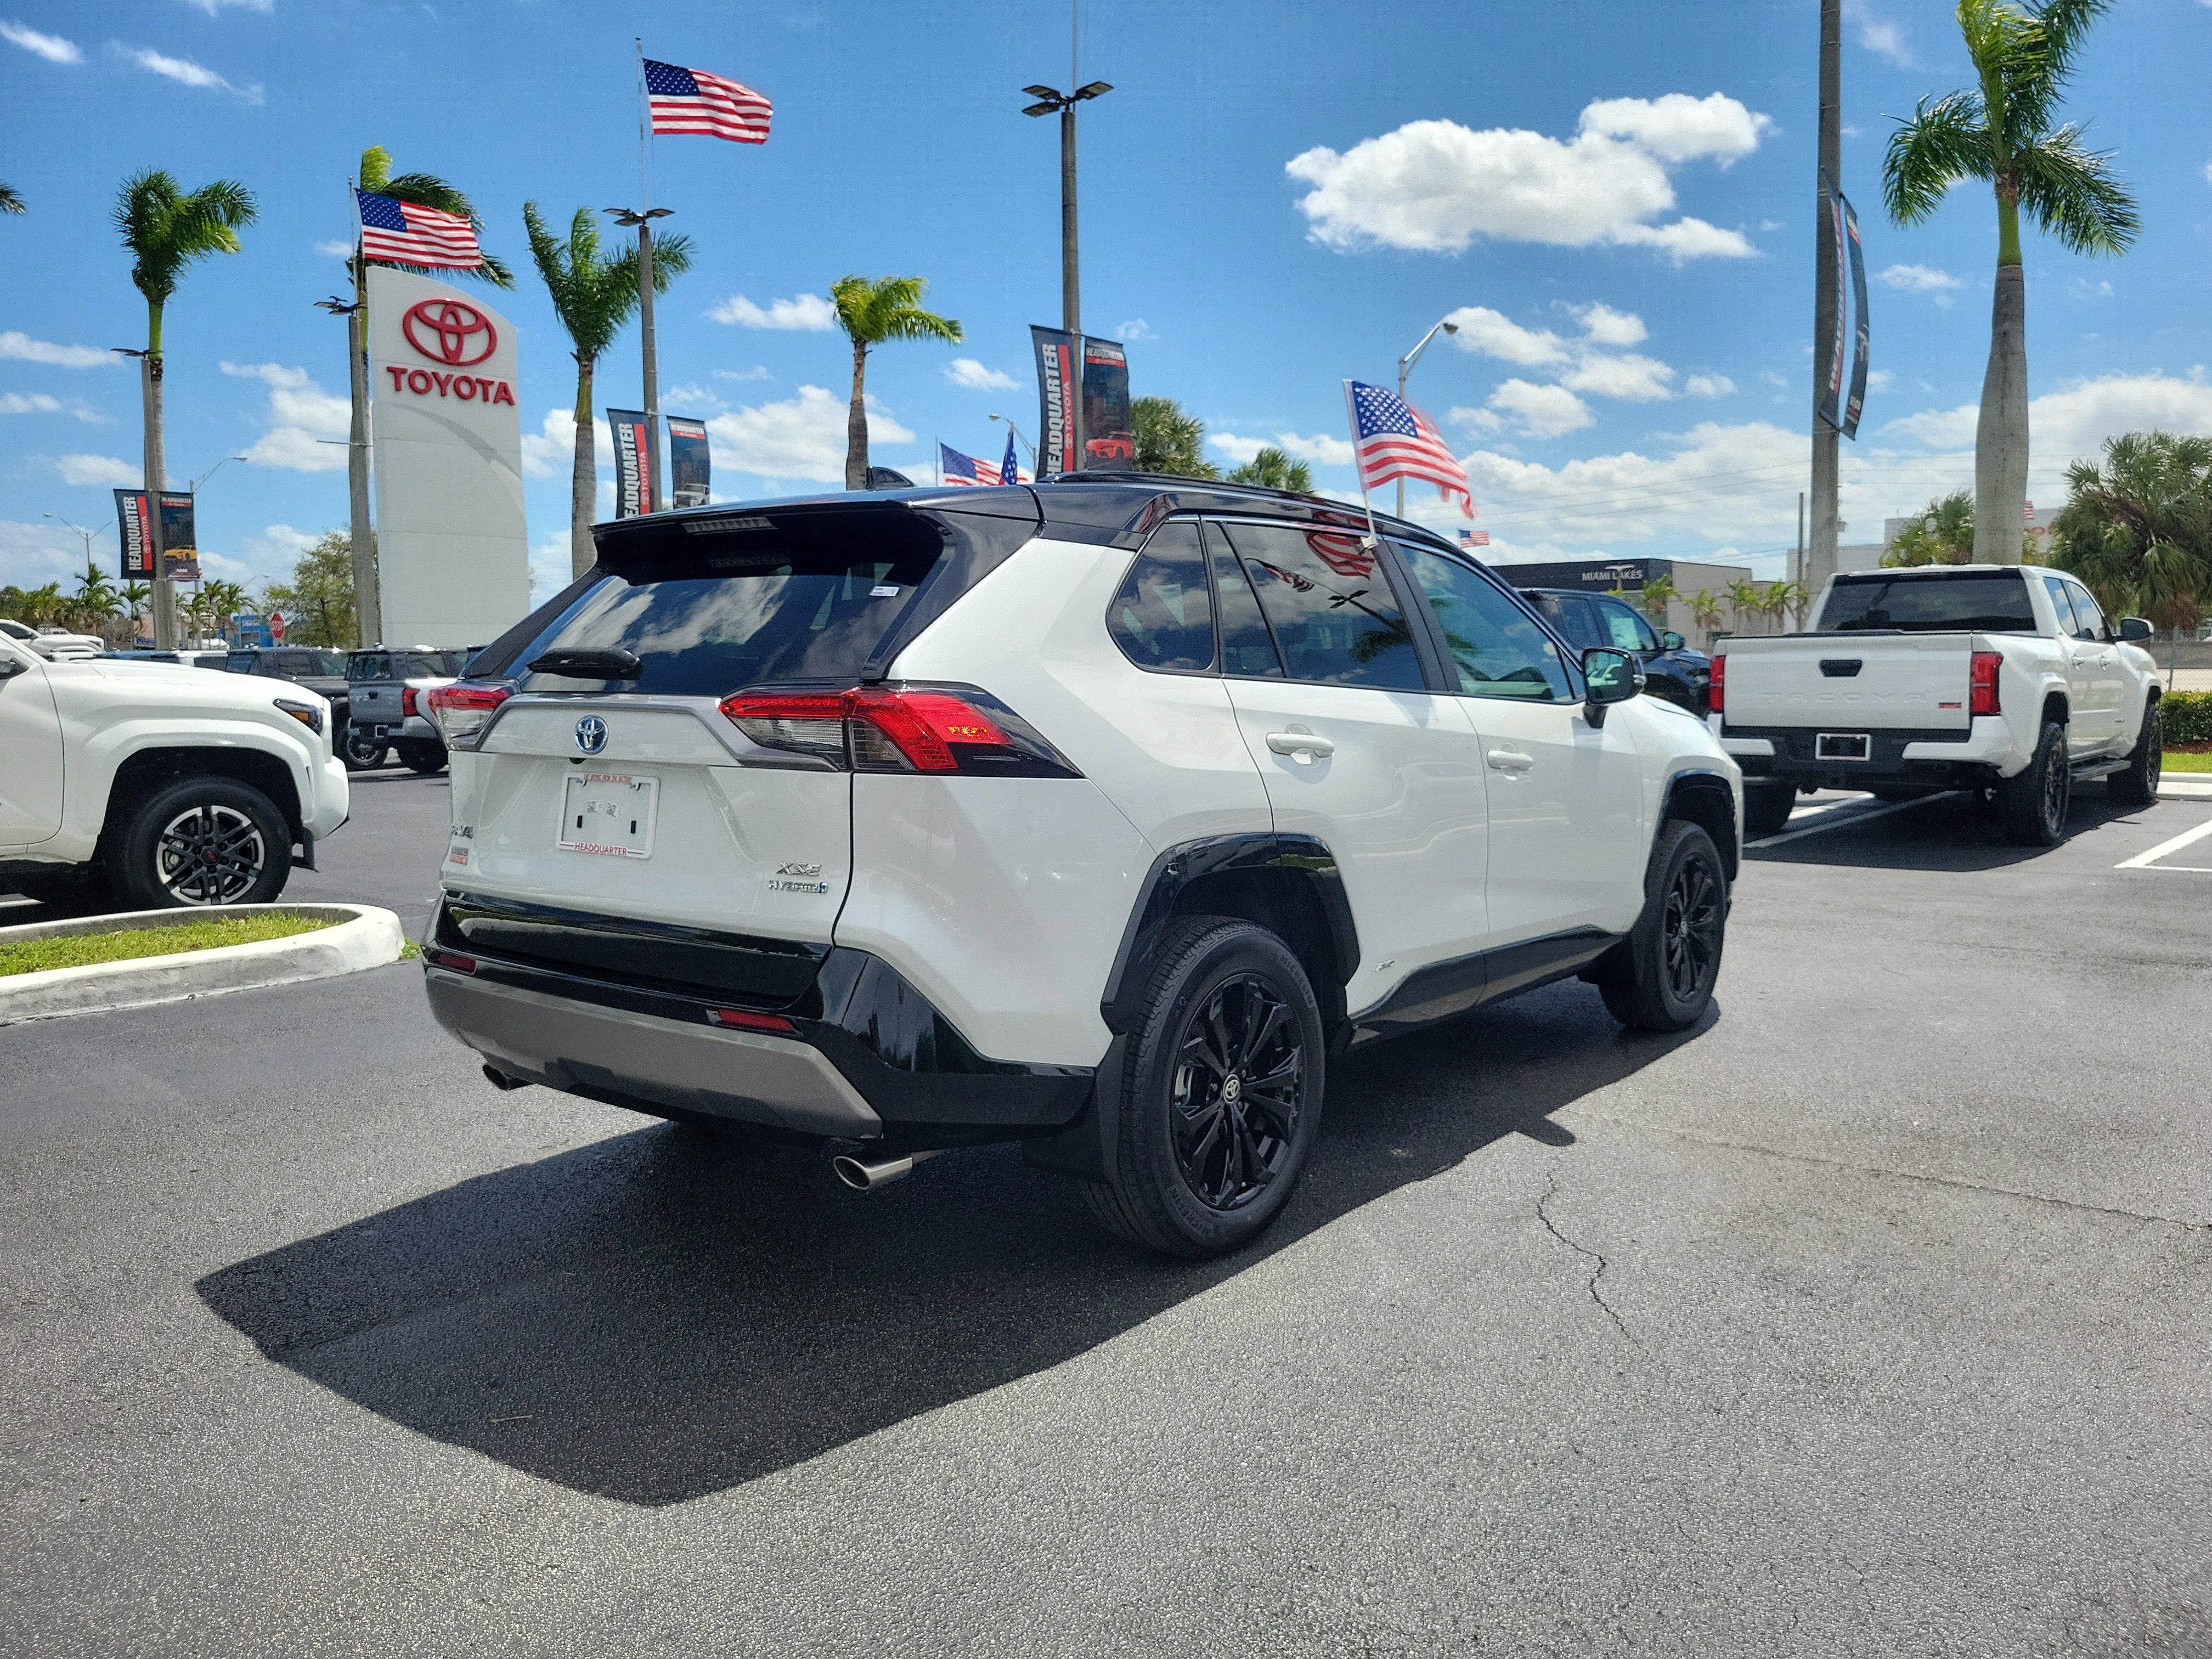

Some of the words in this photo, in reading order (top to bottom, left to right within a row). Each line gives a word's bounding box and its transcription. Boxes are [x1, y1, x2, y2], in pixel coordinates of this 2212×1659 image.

[386, 366, 515, 406] TOYOTA
[1063, 382, 1073, 430] TOYOTA
[1043, 343, 1065, 477] HEADQUARTER
[618, 423, 641, 518] EADQUARTER
[639, 452, 648, 492] TOYOTA
[123, 496, 142, 571] HEADQUARTER
[141, 515, 150, 544] TOYOTA
[1581, 571, 1610, 580] MIAMI
[272, 620, 284, 631] STOP
[1759, 692, 1926, 704] TACOMA
[575, 842, 627, 855] HEADQUARTER
[776, 861, 822, 876] XSE
[769, 880, 818, 893] HYBRID
[1280, 954, 1313, 1005] MICHELIN
[1169, 1188, 1211, 1235] MICHELIN
